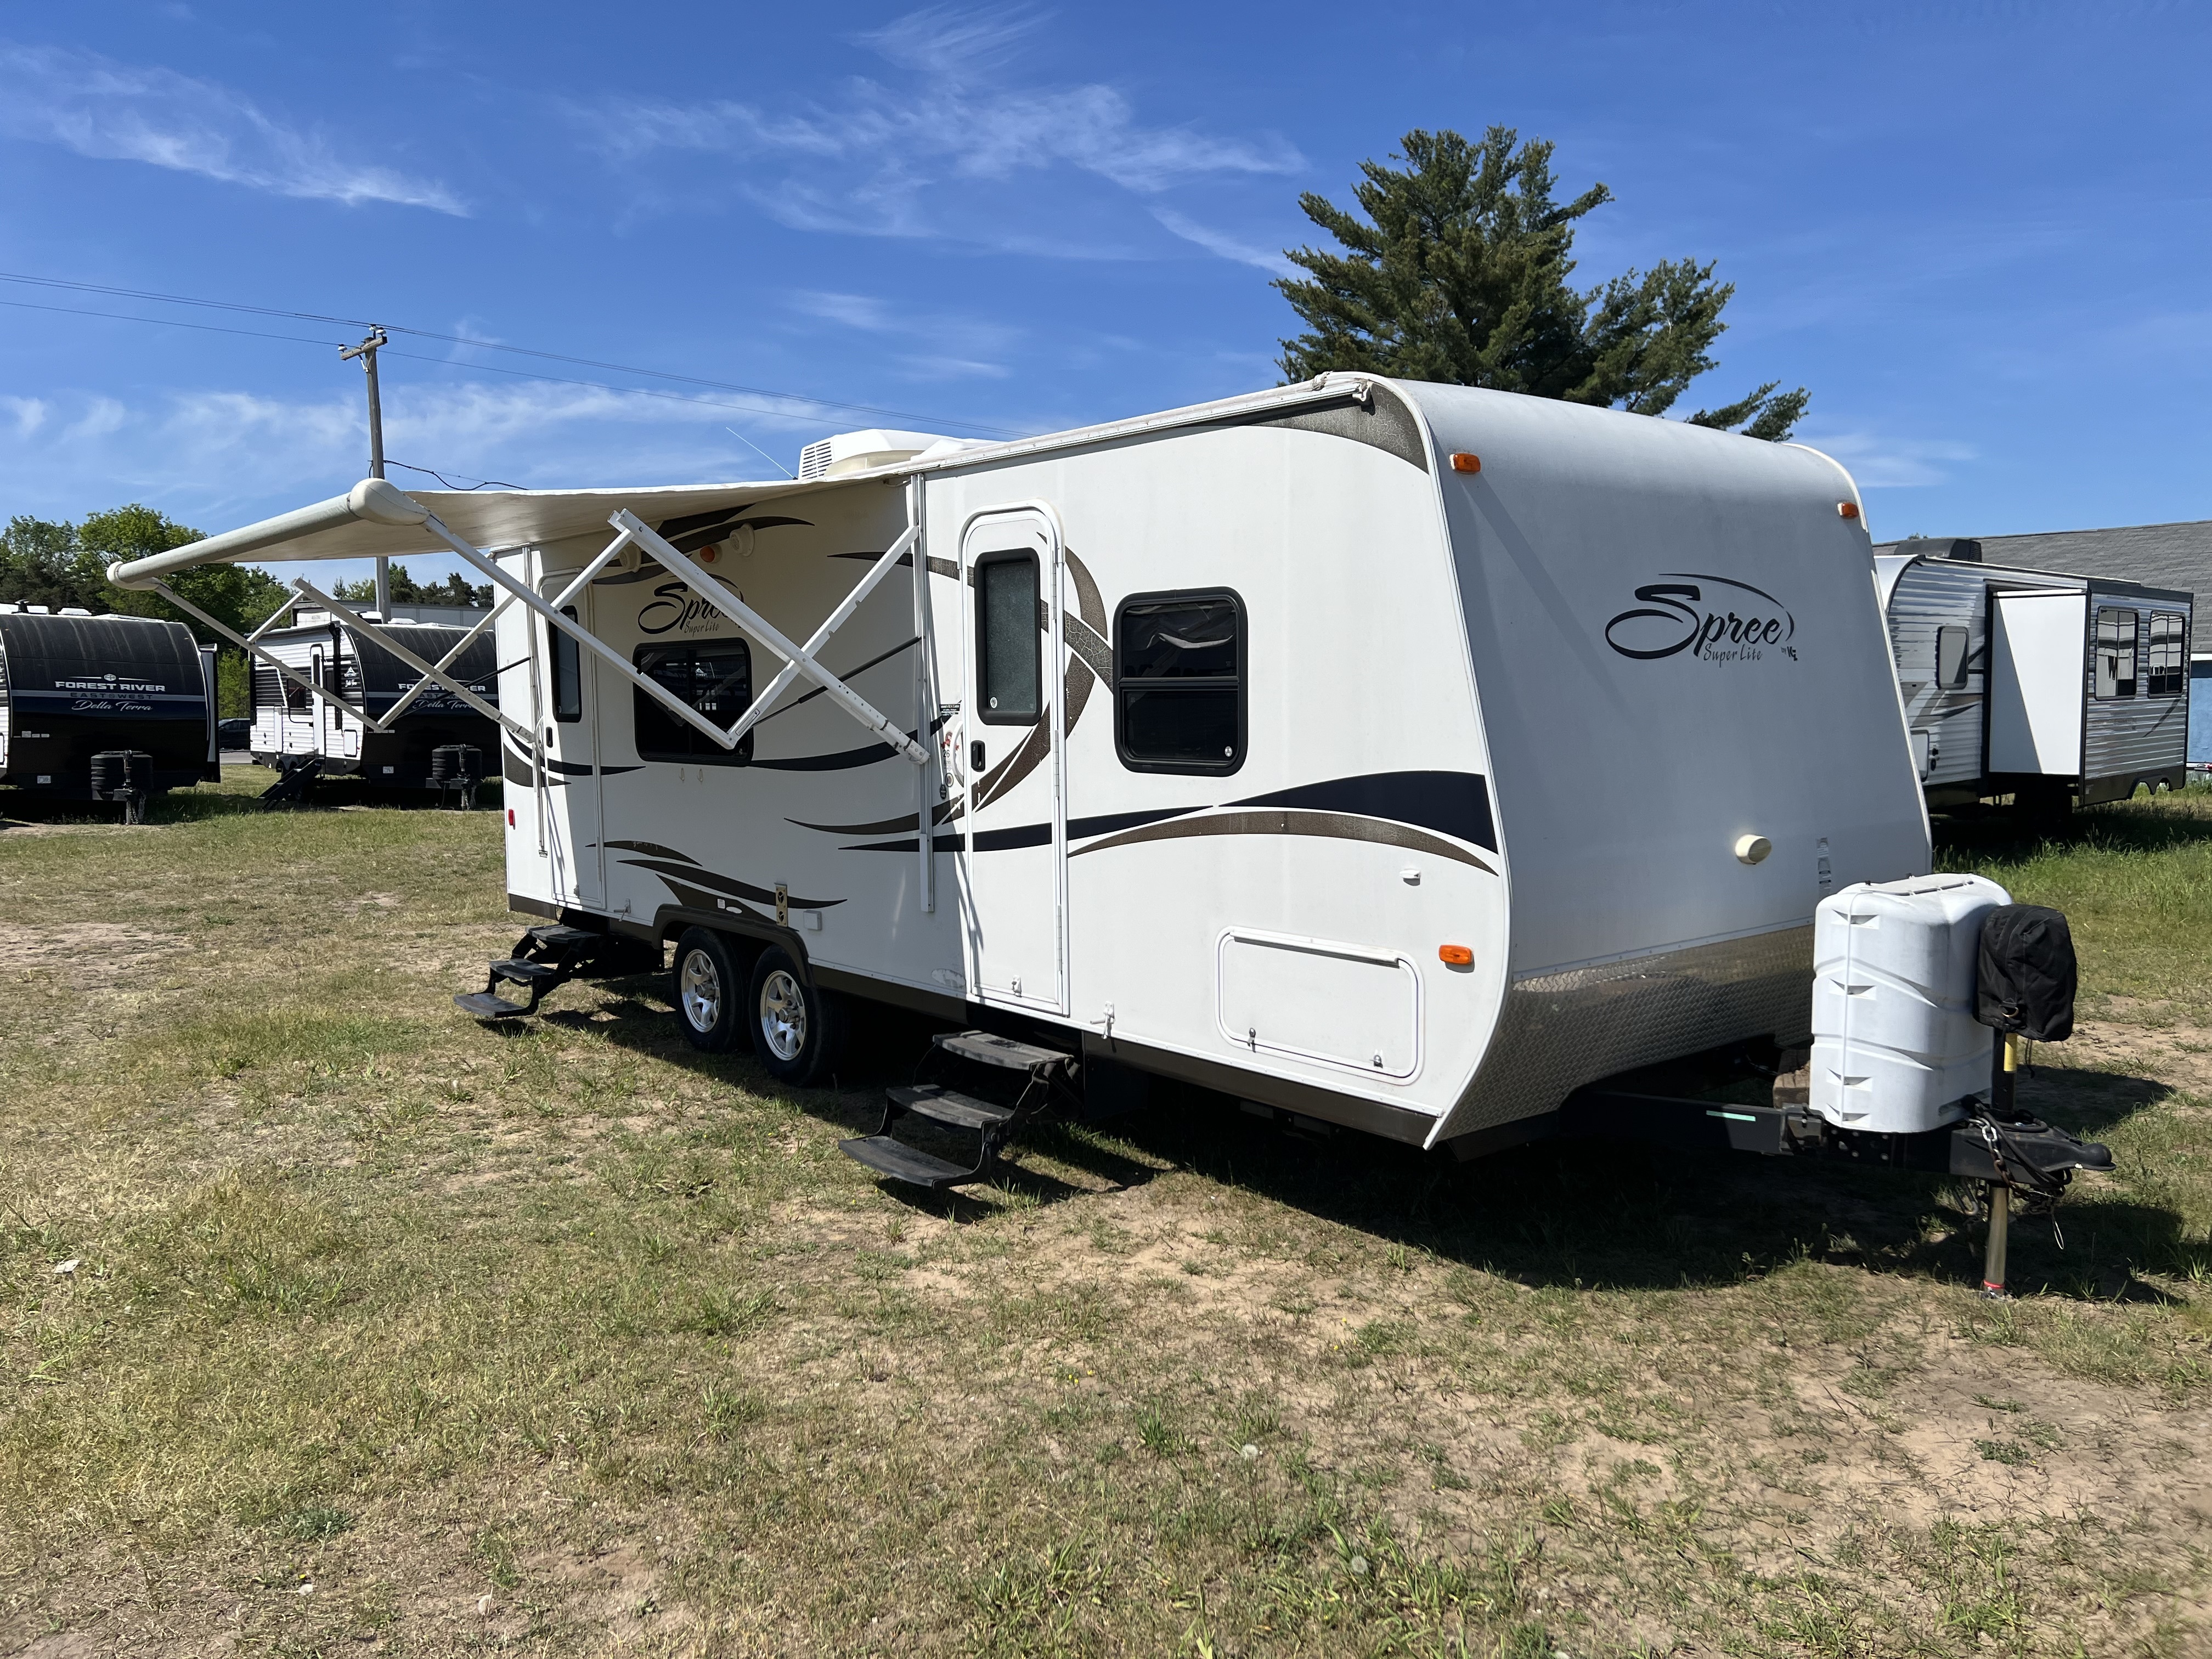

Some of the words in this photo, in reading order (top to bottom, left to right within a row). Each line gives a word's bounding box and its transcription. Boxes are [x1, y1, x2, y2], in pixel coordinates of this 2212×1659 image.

[637, 581, 729, 635] Spre
[684, 620, 705, 637] Super
[705, 619, 720, 632] Lite
[1605, 583, 1783, 660] Spree
[1703, 643, 1737, 668] Super
[1740, 644, 1763, 661] Lite
[54, 681, 117, 690] FOREST
[119, 684, 166, 692] RIVER
[71, 699, 112, 710] Della
[115, 701, 154, 712] Terra
